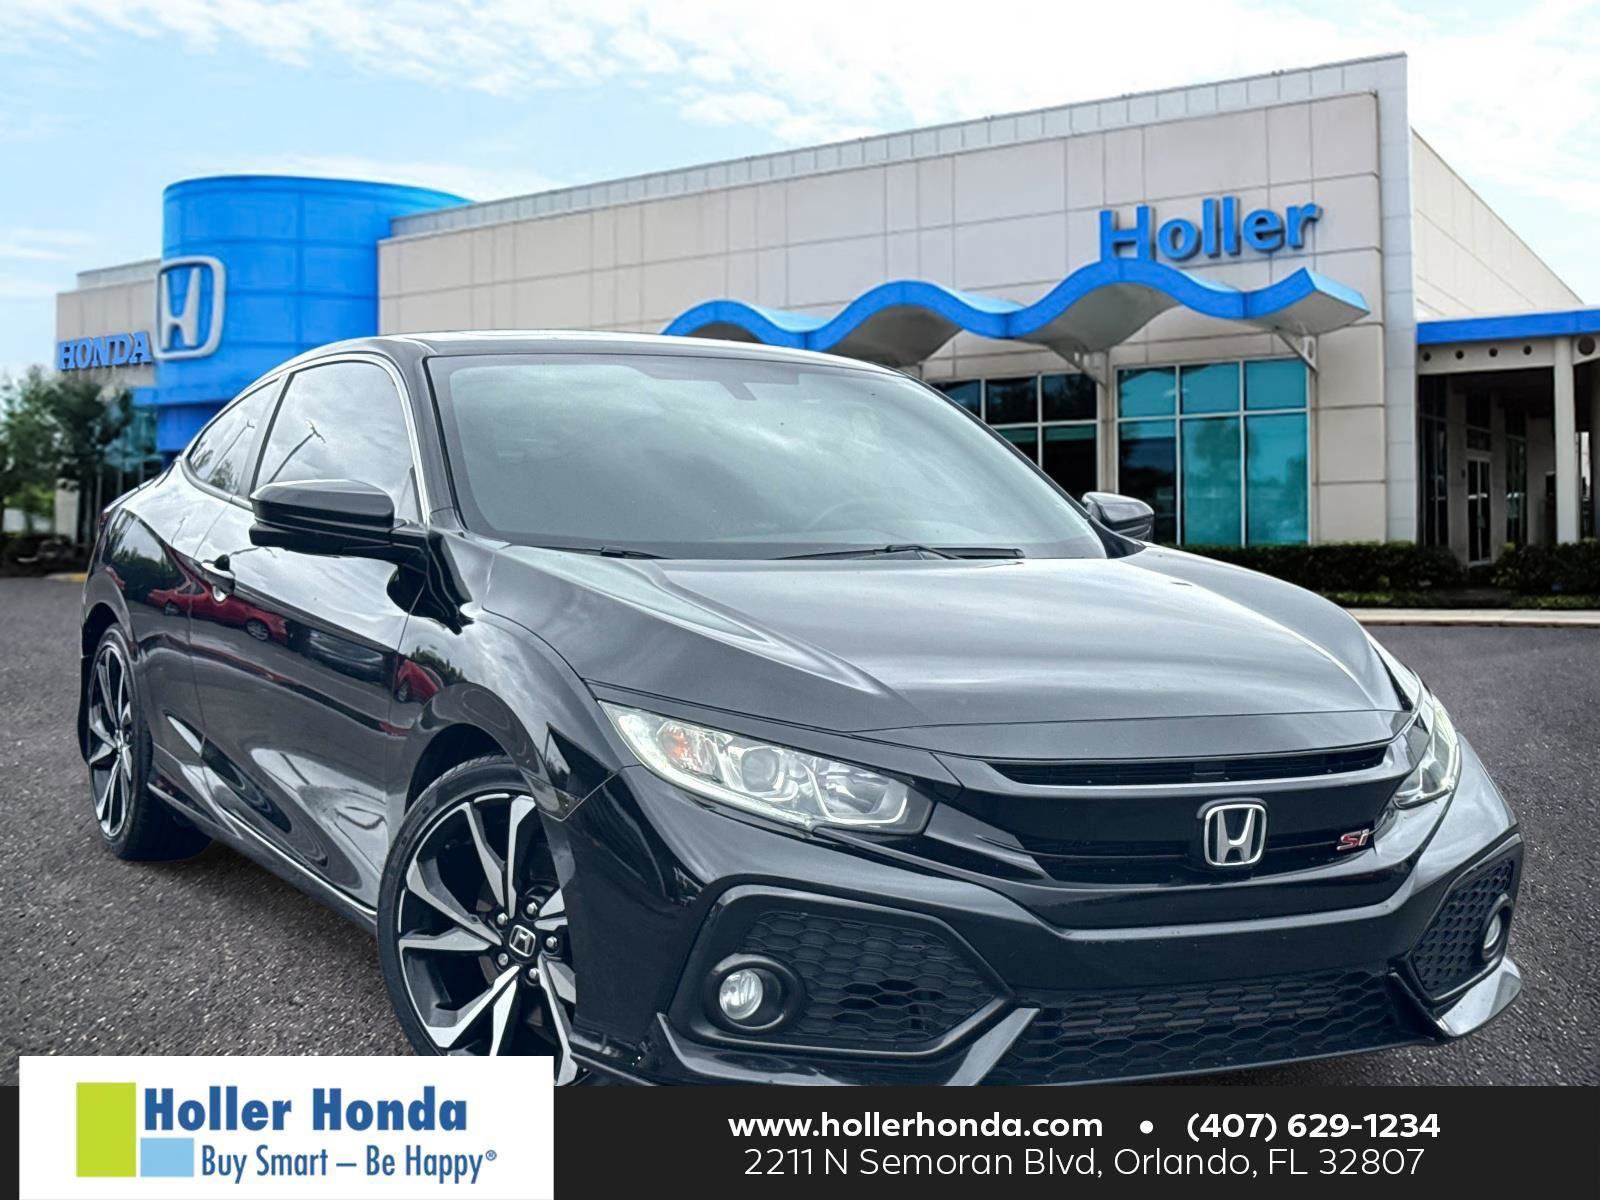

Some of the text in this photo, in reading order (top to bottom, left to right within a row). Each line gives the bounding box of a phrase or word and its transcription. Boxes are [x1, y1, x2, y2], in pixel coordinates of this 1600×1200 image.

[1099, 195, 1322, 262] Holler
[58, 331, 152, 371] HONDA
[1336, 829, 1370, 851] Si
